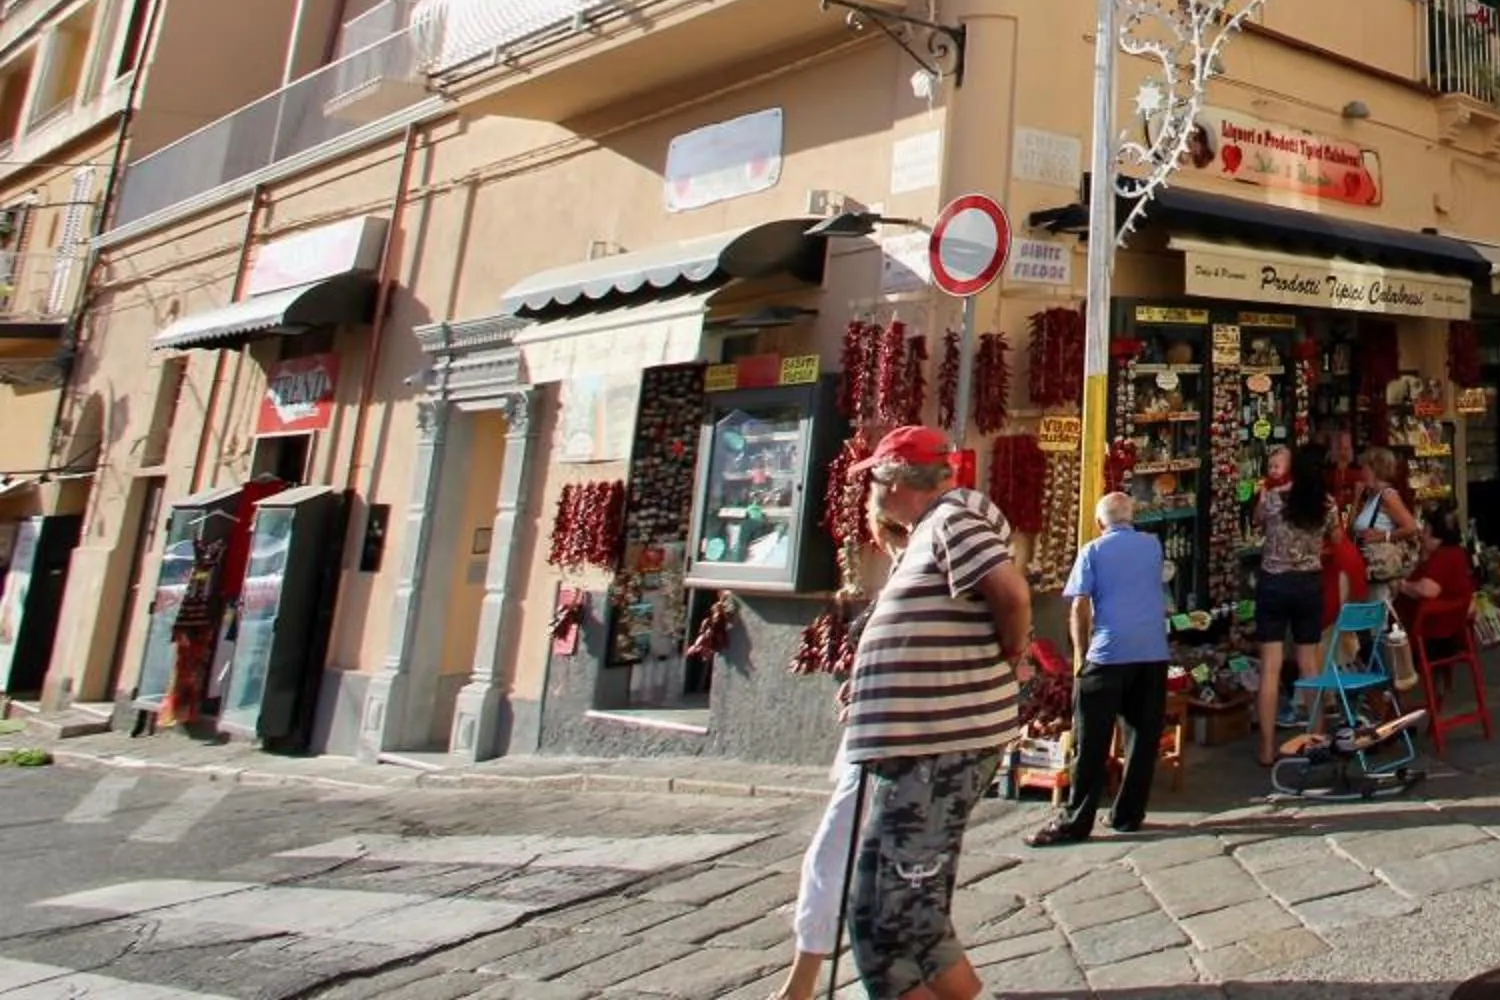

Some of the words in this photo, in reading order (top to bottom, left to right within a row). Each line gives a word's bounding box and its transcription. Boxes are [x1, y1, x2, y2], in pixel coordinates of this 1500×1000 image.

[1263, 129, 1299, 153] Prodotti
[1260, 265, 1321, 297] Prodotti
[1325, 275, 1365, 304] Tipici
[1368, 280, 1425, 306] Calabresi
